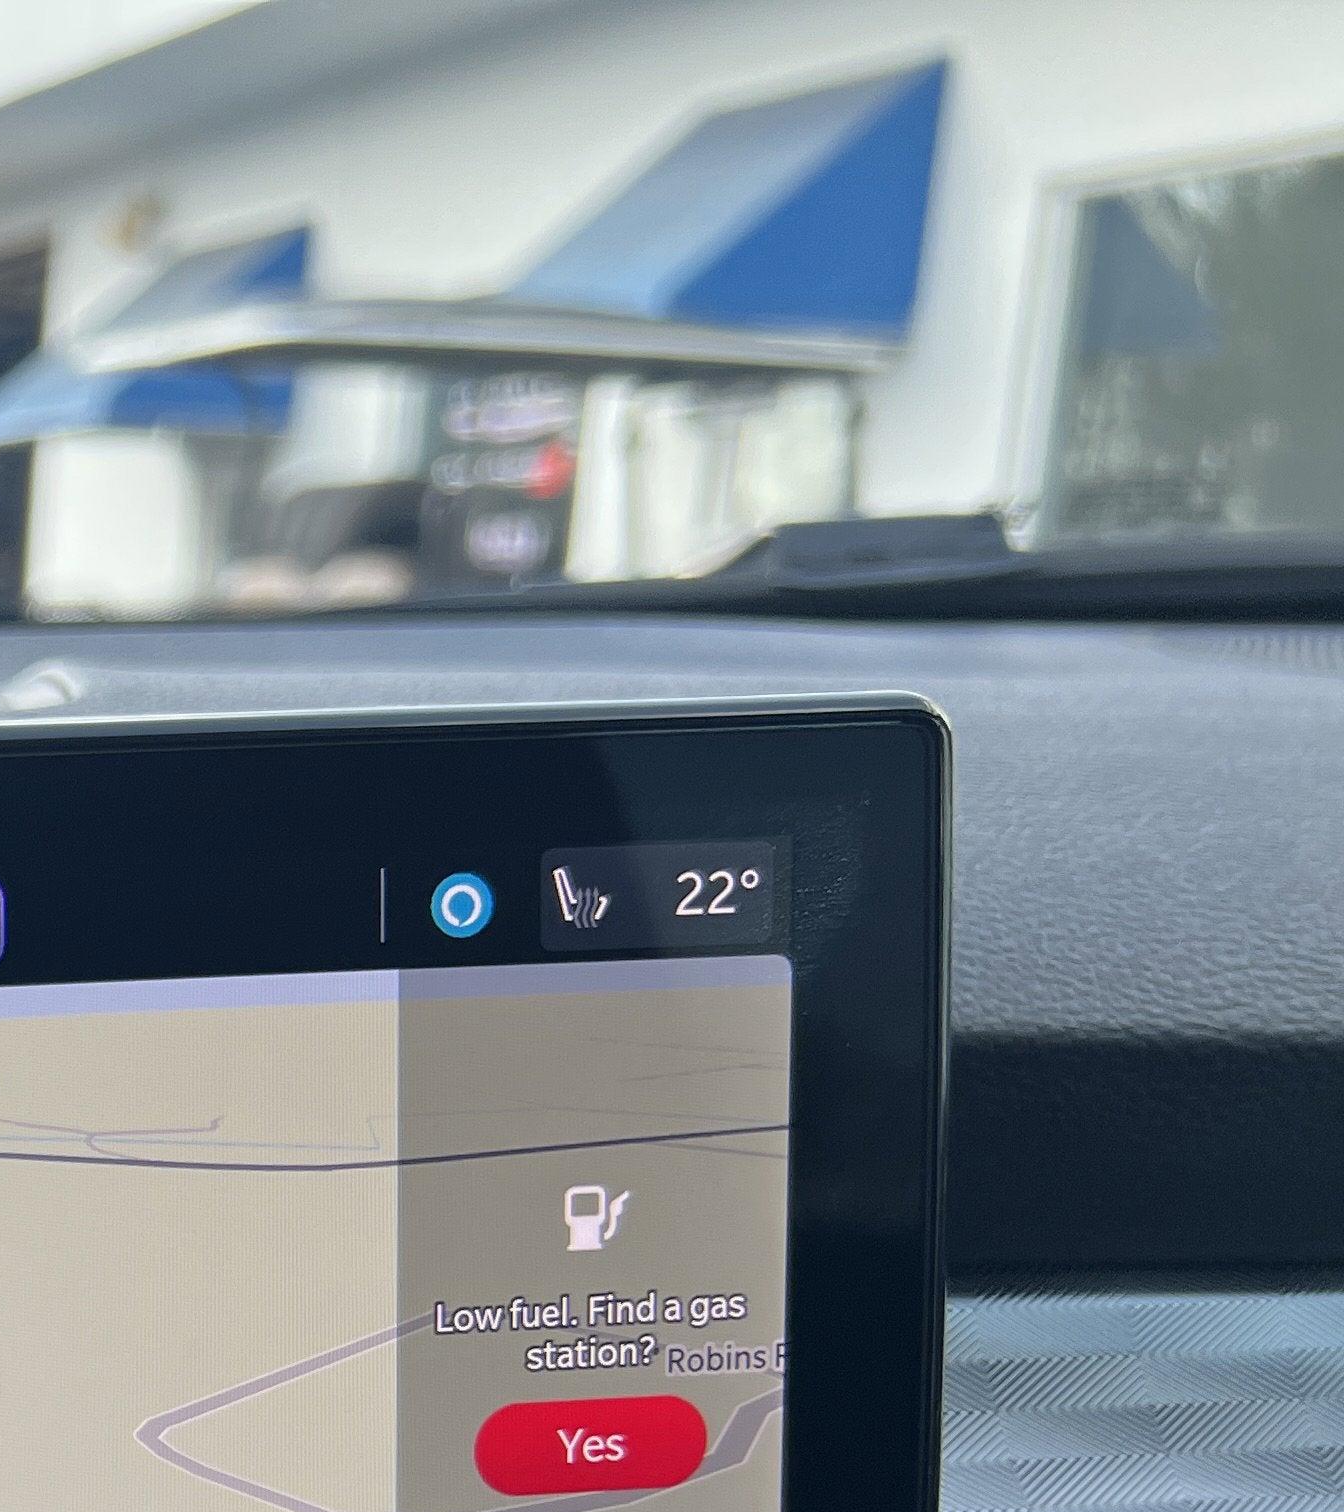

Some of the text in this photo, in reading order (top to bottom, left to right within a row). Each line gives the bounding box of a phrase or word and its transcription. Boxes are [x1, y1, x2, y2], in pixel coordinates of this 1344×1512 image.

[675, 869, 759, 916] 22°
[434, 1292, 747, 1334] Low fuel. Find a gas
[526, 1337, 657, 1371] station?
[668, 1344, 766, 1373] Robins
[556, 1428, 626, 1464] Yes
